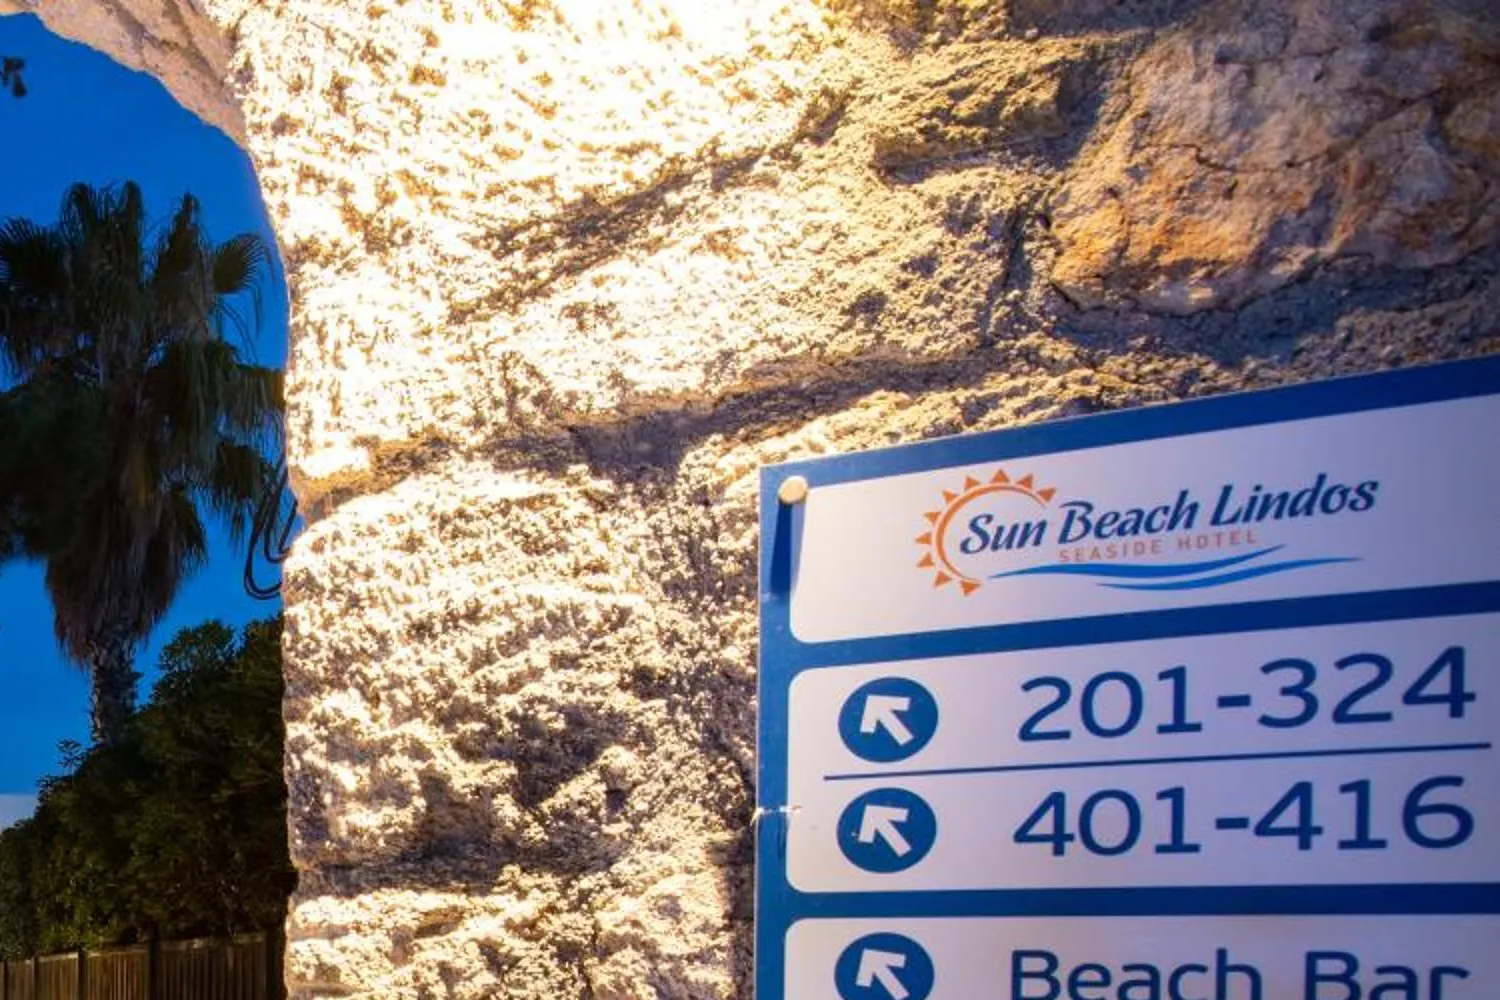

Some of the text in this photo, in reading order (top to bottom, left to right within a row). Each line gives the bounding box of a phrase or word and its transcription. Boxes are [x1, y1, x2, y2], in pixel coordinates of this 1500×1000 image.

[960, 472, 1380, 556] Sun Beach Lindos
[1059, 530, 1258, 564] SEASIDE HOTEL
[1018, 646, 1477, 742] 201-324
[1013, 775, 1475, 857] 401-416
